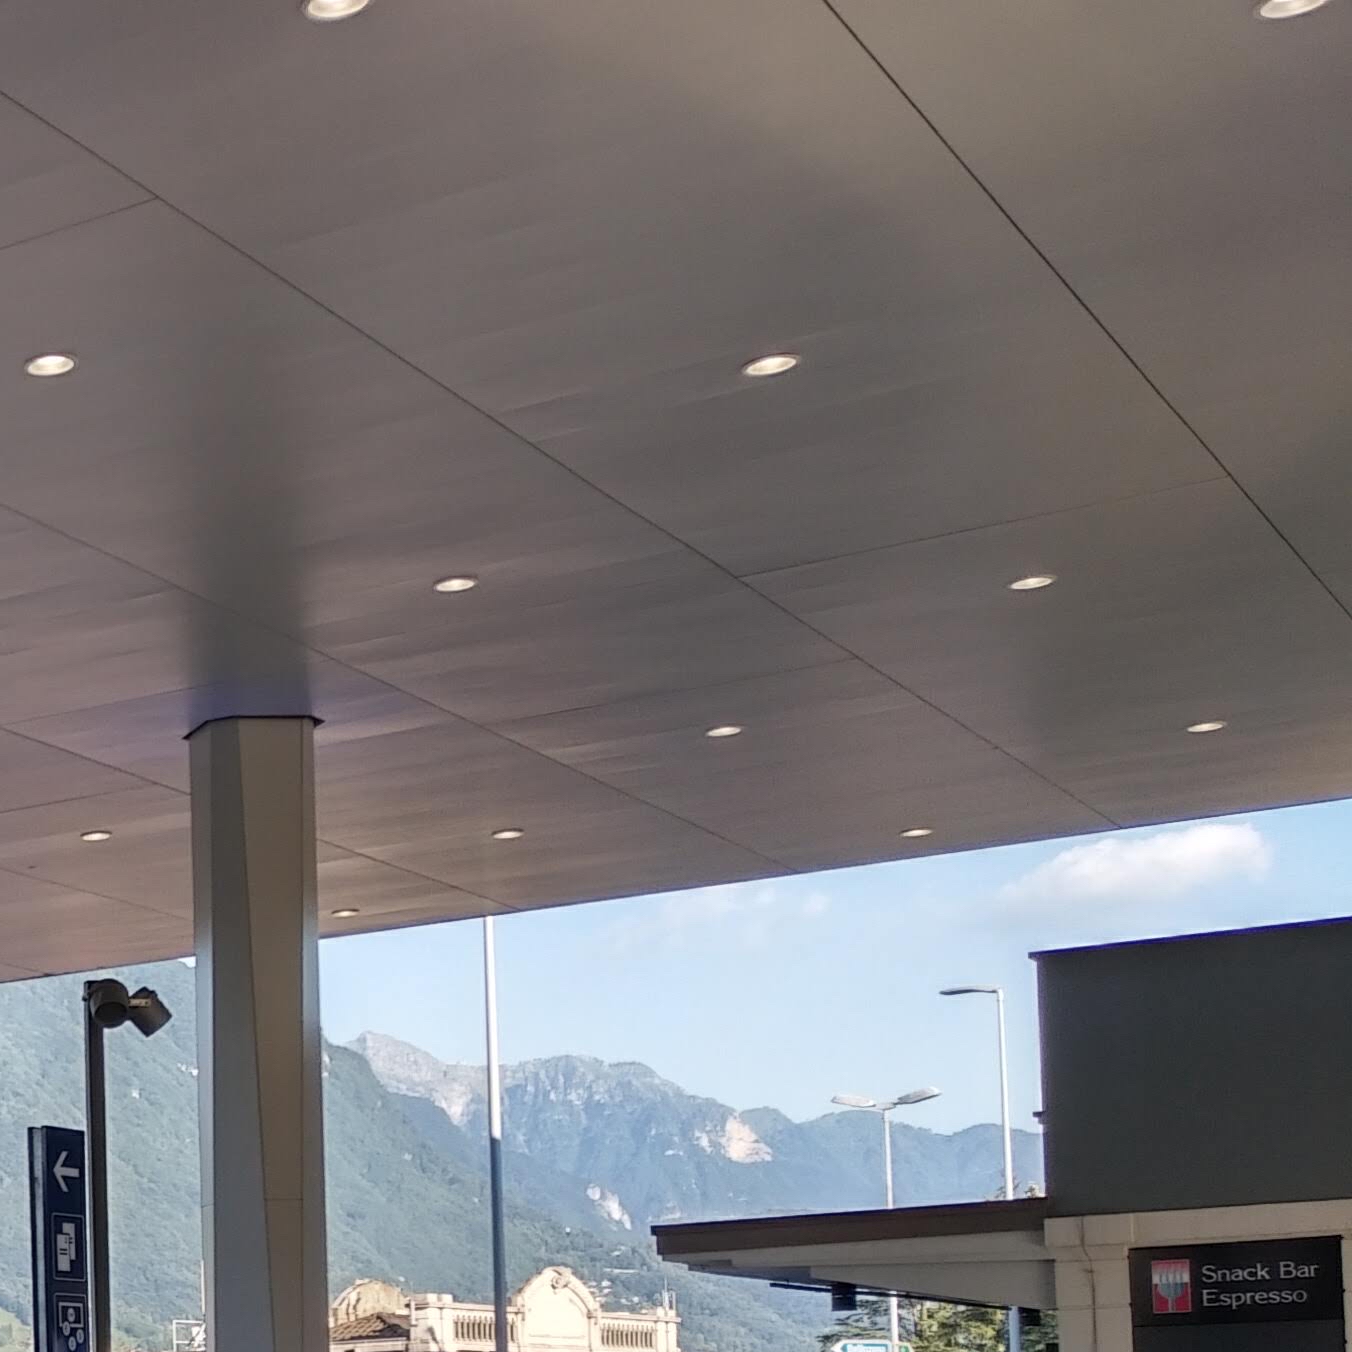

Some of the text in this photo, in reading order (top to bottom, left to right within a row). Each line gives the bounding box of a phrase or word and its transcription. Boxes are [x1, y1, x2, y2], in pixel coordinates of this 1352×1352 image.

[1201, 1261, 1321, 1283] Snack Bar
[1202, 1289, 1307, 1309] Espresso
